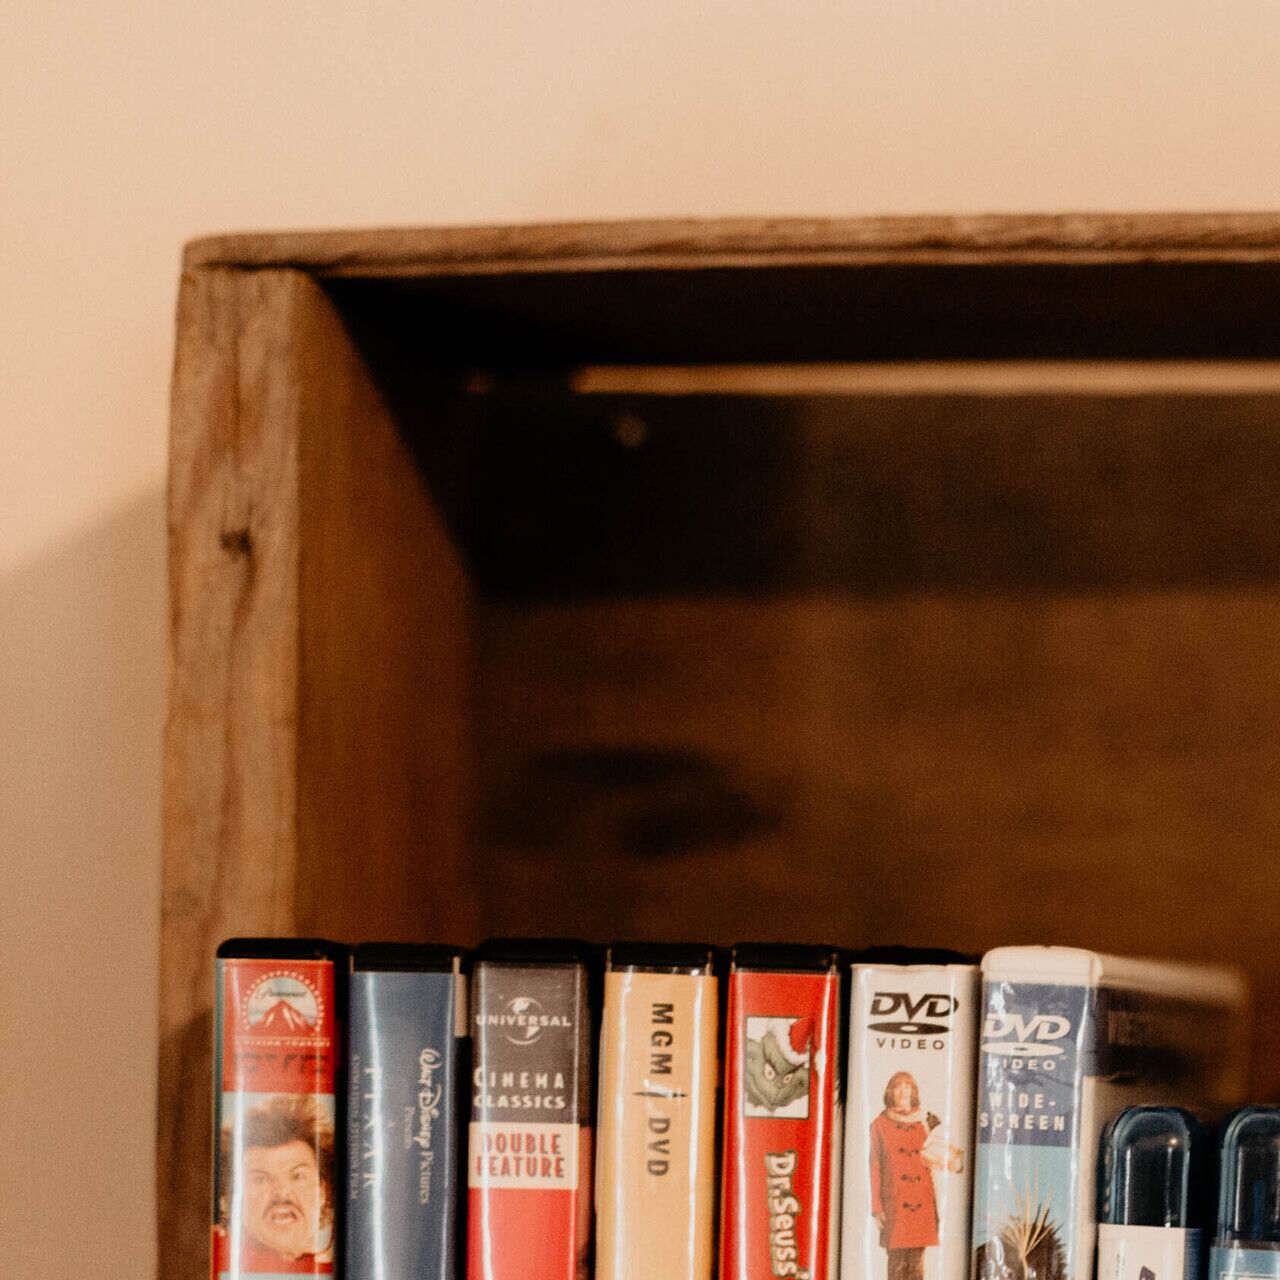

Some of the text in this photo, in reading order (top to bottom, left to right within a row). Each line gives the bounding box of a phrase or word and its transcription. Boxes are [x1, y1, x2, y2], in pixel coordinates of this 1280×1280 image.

[868, 991, 959, 1017] DVD
[475, 1015, 572, 1027] UNIVERSAL
[982, 1013, 1072, 1043] DVD
[648, 1001, 674, 1075] MGM
[876, 1038, 946, 1050] VIDEO
[472, 1067, 565, 1090] CINEMA
[472, 1095, 566, 1109] CLASSICS
[979, 1112, 1066, 1132] SCREEN
[480, 1132, 562, 1155] DOUBLE
[647, 1117, 671, 1177] DVD
[419, 1149, 434, 1204] Pictures
[477, 1156, 565, 1179] FEATURE
